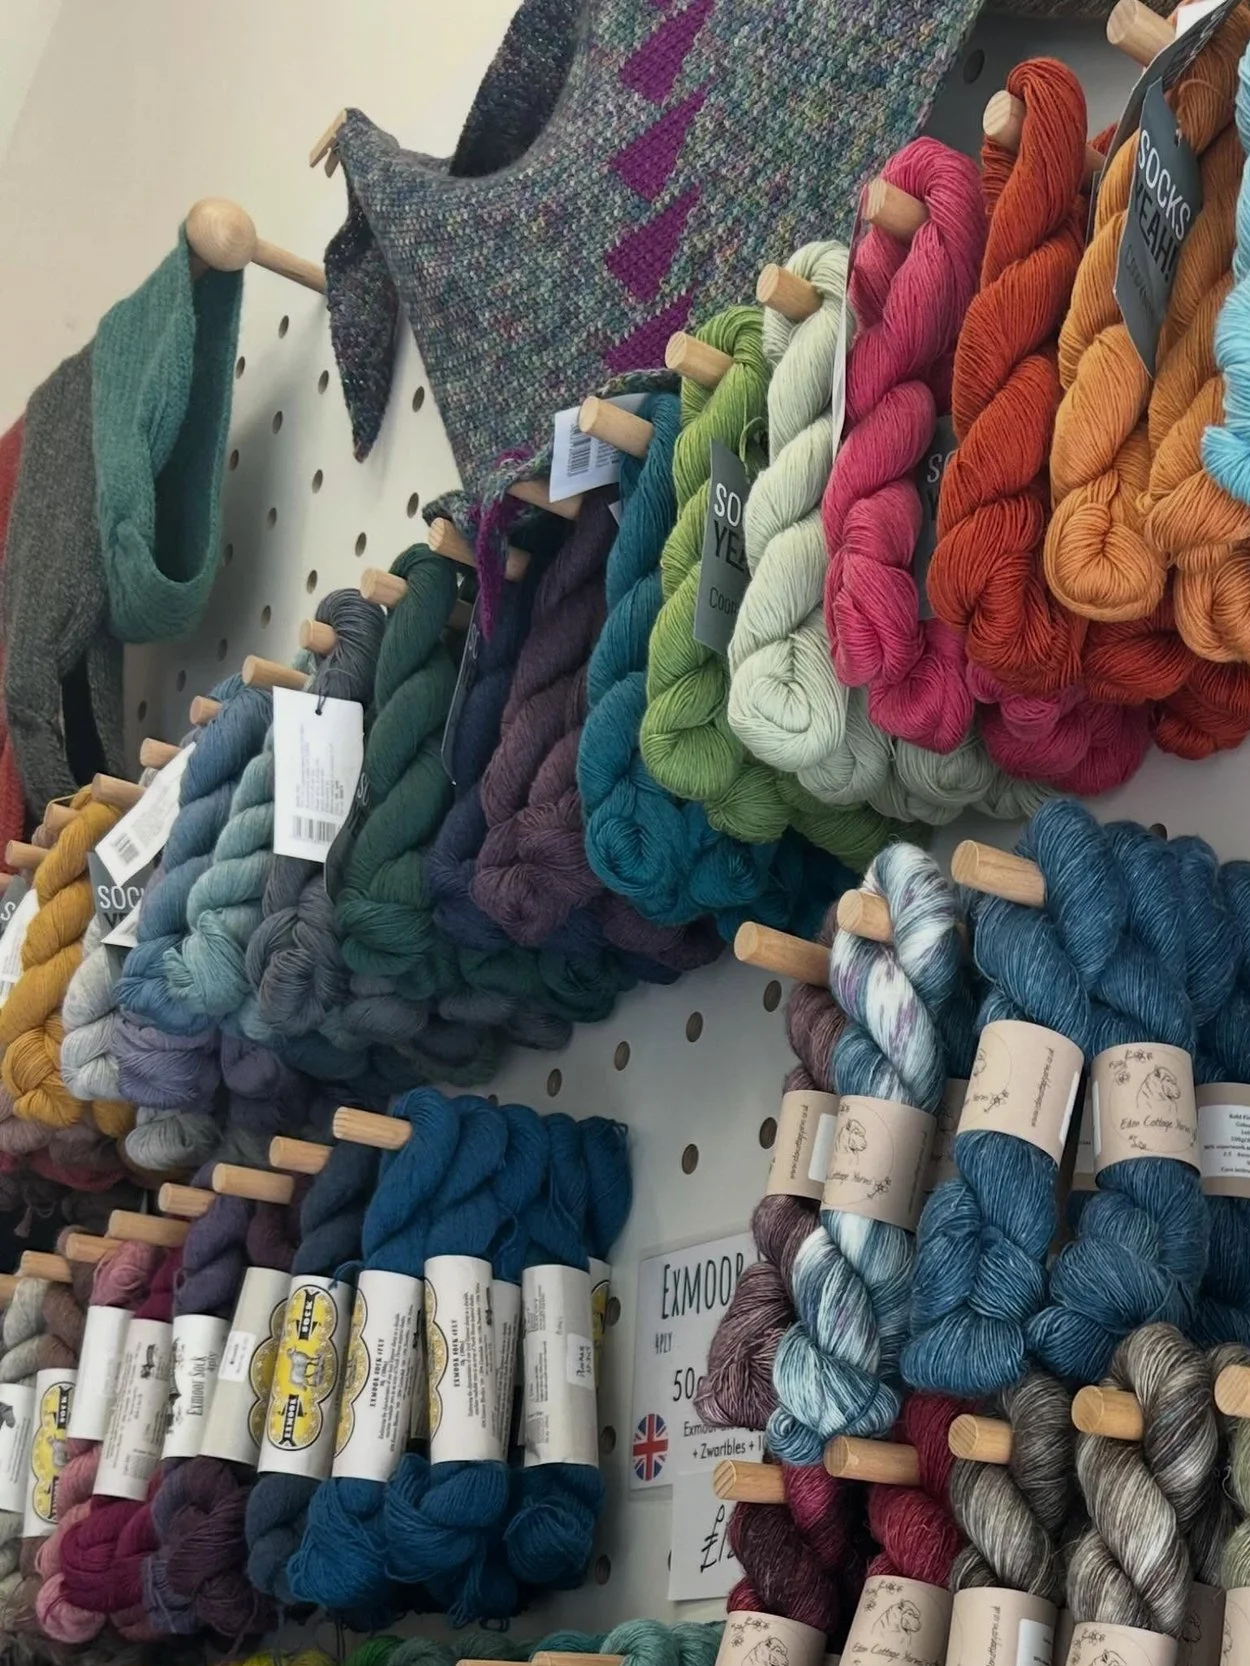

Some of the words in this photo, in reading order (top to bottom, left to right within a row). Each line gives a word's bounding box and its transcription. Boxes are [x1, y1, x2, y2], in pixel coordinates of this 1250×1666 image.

[1137, 130, 1192, 241] SOCKS
[98, 885, 146, 910] SOC
[1143, 1115, 1173, 1132] Cottage
[301, 1300, 313, 1332] SOCK
[188, 1356, 208, 1378] Sock
[186, 1380, 205, 1416] Exmoor
[700, 1437, 746, 1459] Zwartbles
[871, 1643, 900, 1663] Cottage
